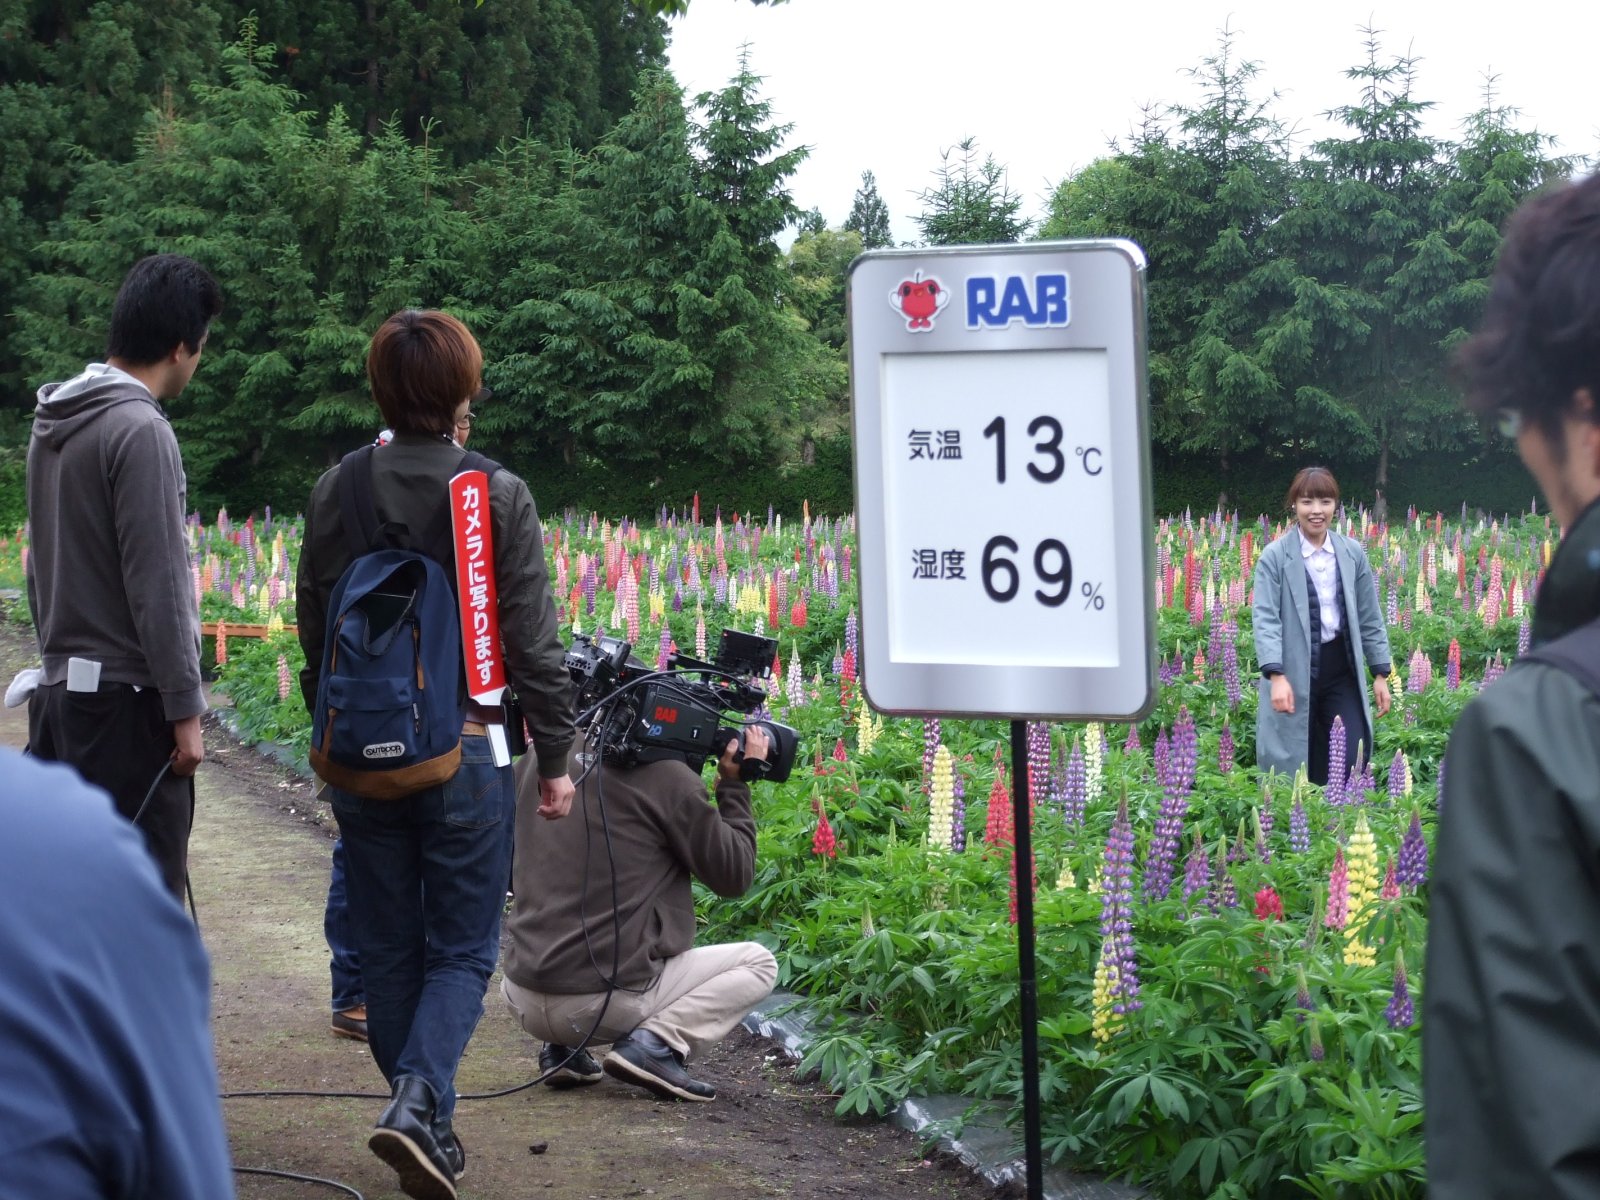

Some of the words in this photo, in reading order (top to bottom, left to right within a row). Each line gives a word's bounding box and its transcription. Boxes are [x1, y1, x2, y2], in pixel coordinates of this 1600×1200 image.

[967, 274, 1068, 326] RAB
[908, 429, 963, 461] 気温
[911, 549, 967, 581] 湿度
[462, 486, 494, 686] カメラに写ります
[366, 745, 402, 755] OUTDOOR
